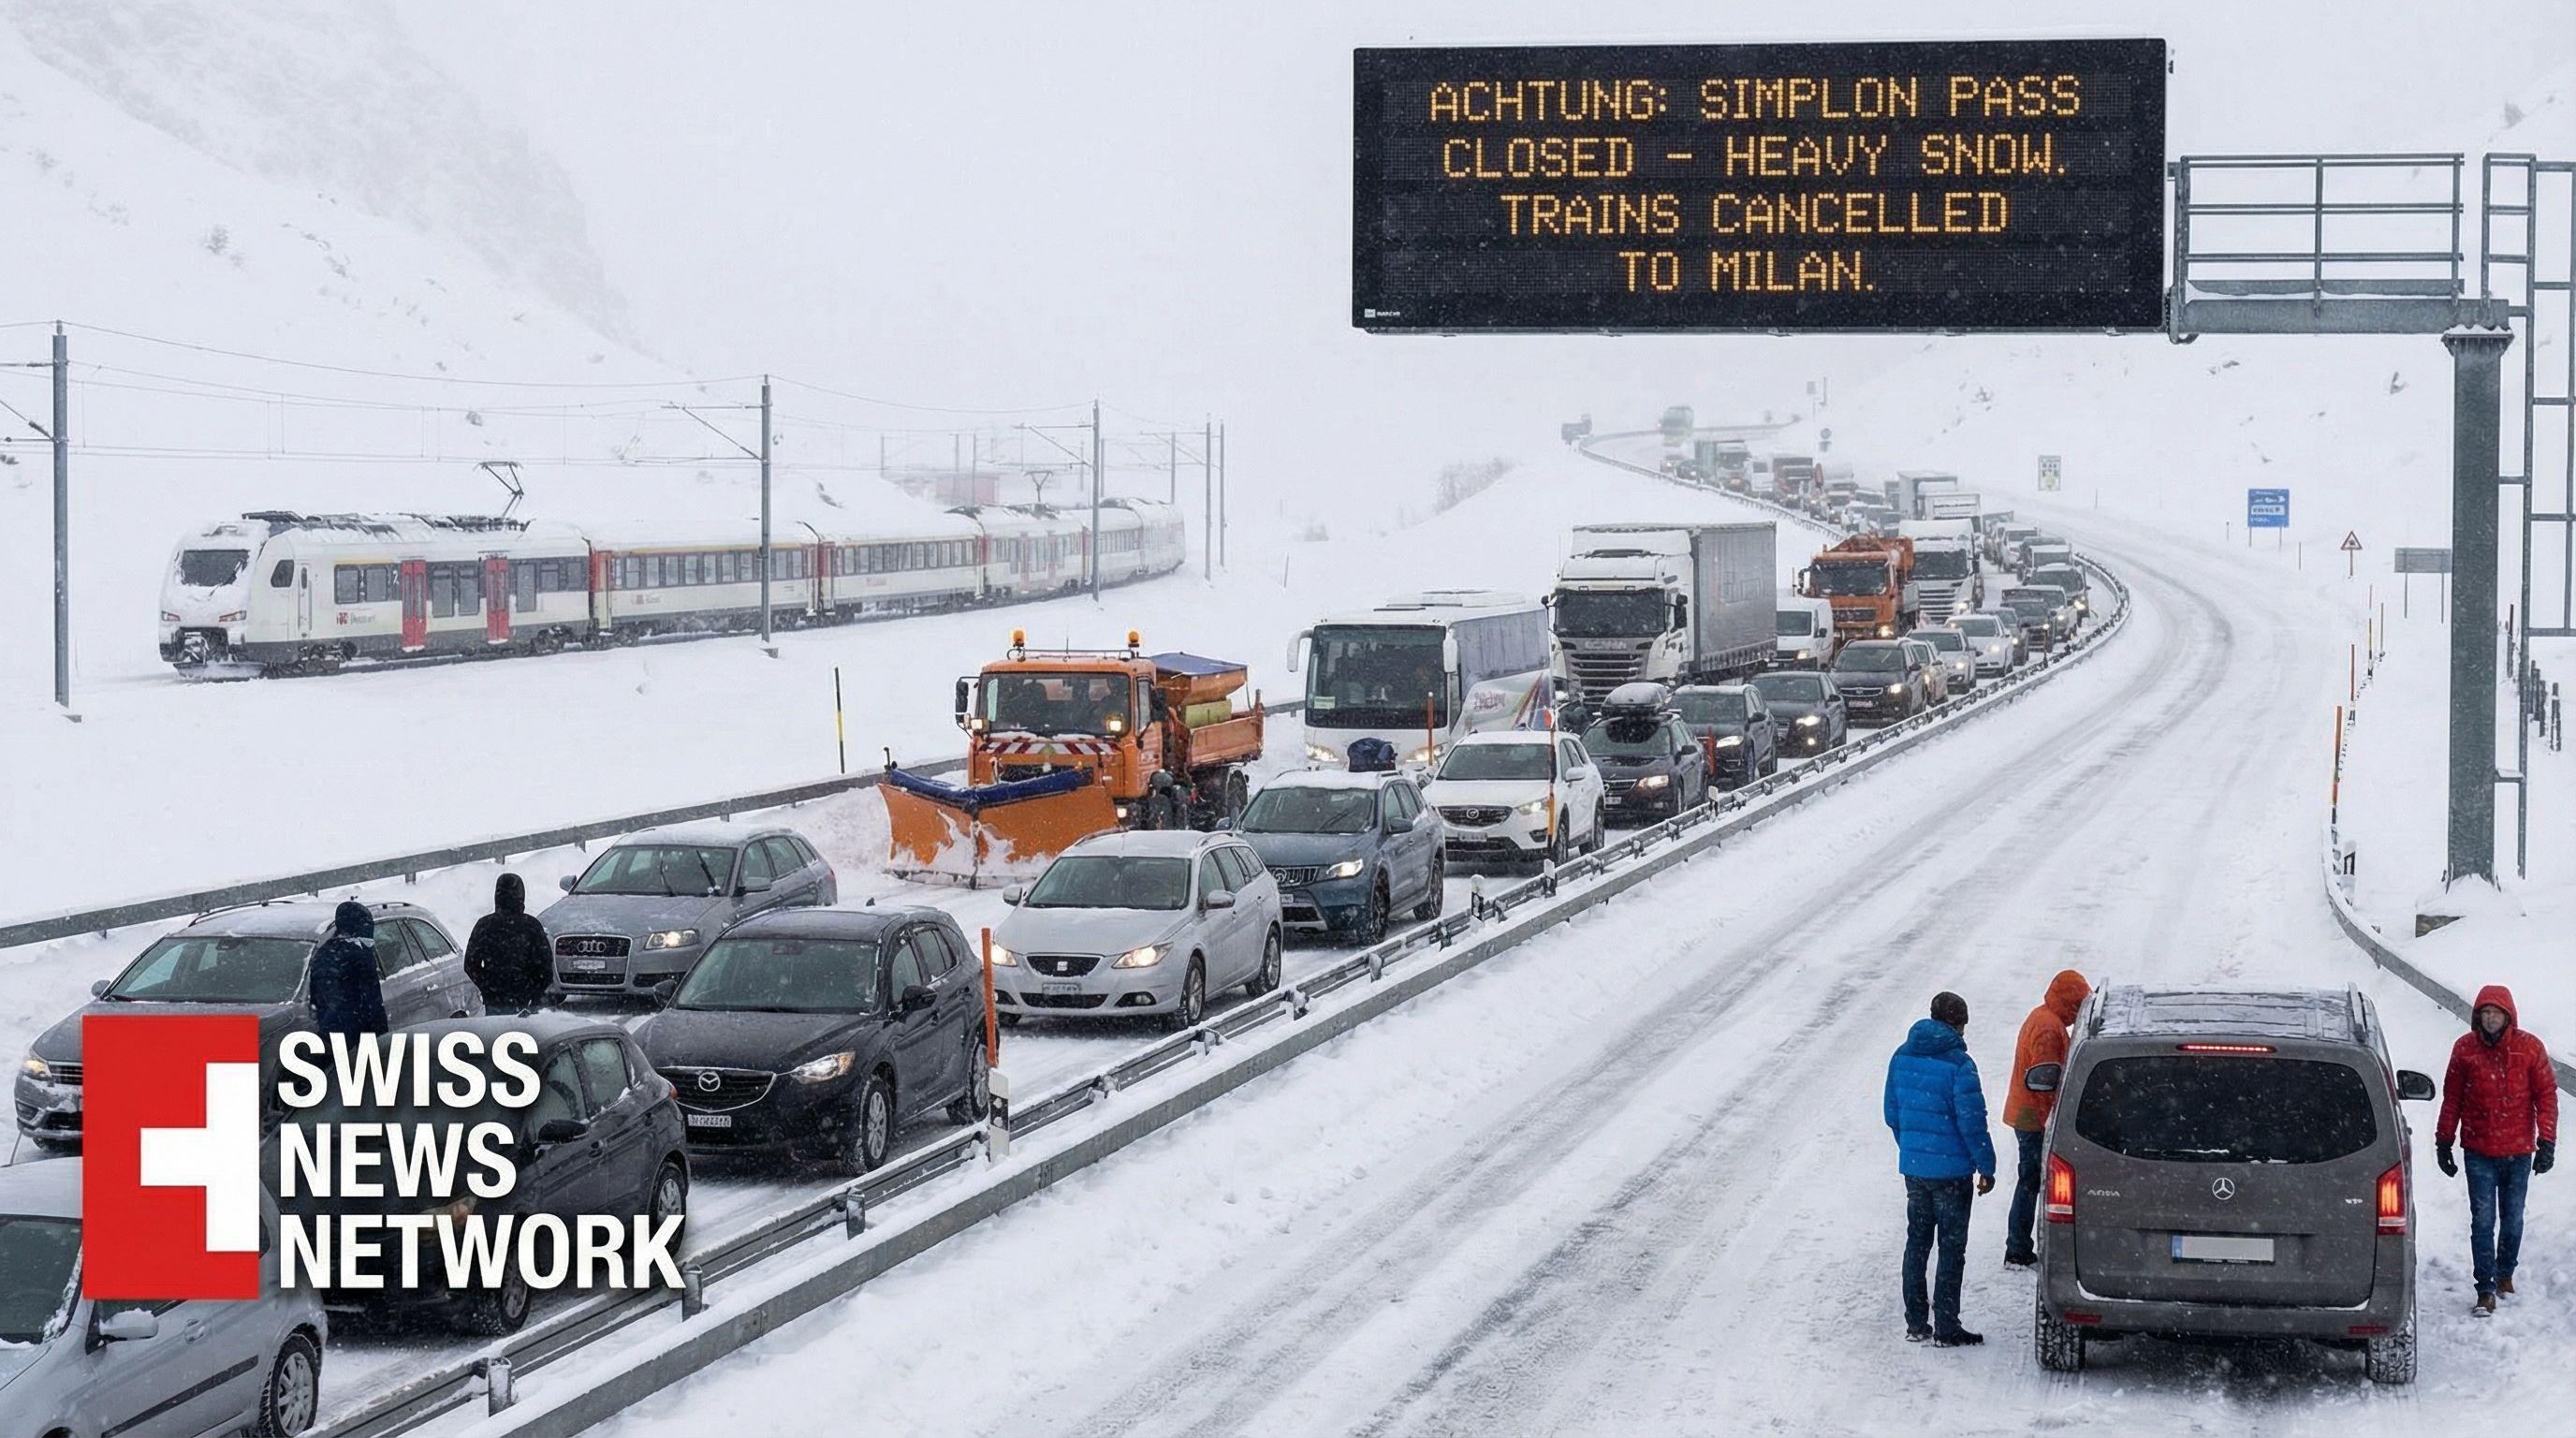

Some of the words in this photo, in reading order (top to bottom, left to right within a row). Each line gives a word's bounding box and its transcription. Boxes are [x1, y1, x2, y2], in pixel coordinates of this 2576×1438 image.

[1430, 81, 1667, 122] ACHTUNG:
[1701, 78, 1918, 120] SIMPLON
[1949, 75, 2081, 116] PASS
[1442, 138, 1633, 179] CLOSED
[1725, 136, 1887, 176] HEAVY
[1922, 133, 2066, 175] SNOW.
[1500, 194, 1680, 235] TRAINS
[1711, 192, 2009, 233] CANCELLED
[1619, 251, 1679, 291] TO
[1710, 251, 1875, 291] MILAN.
